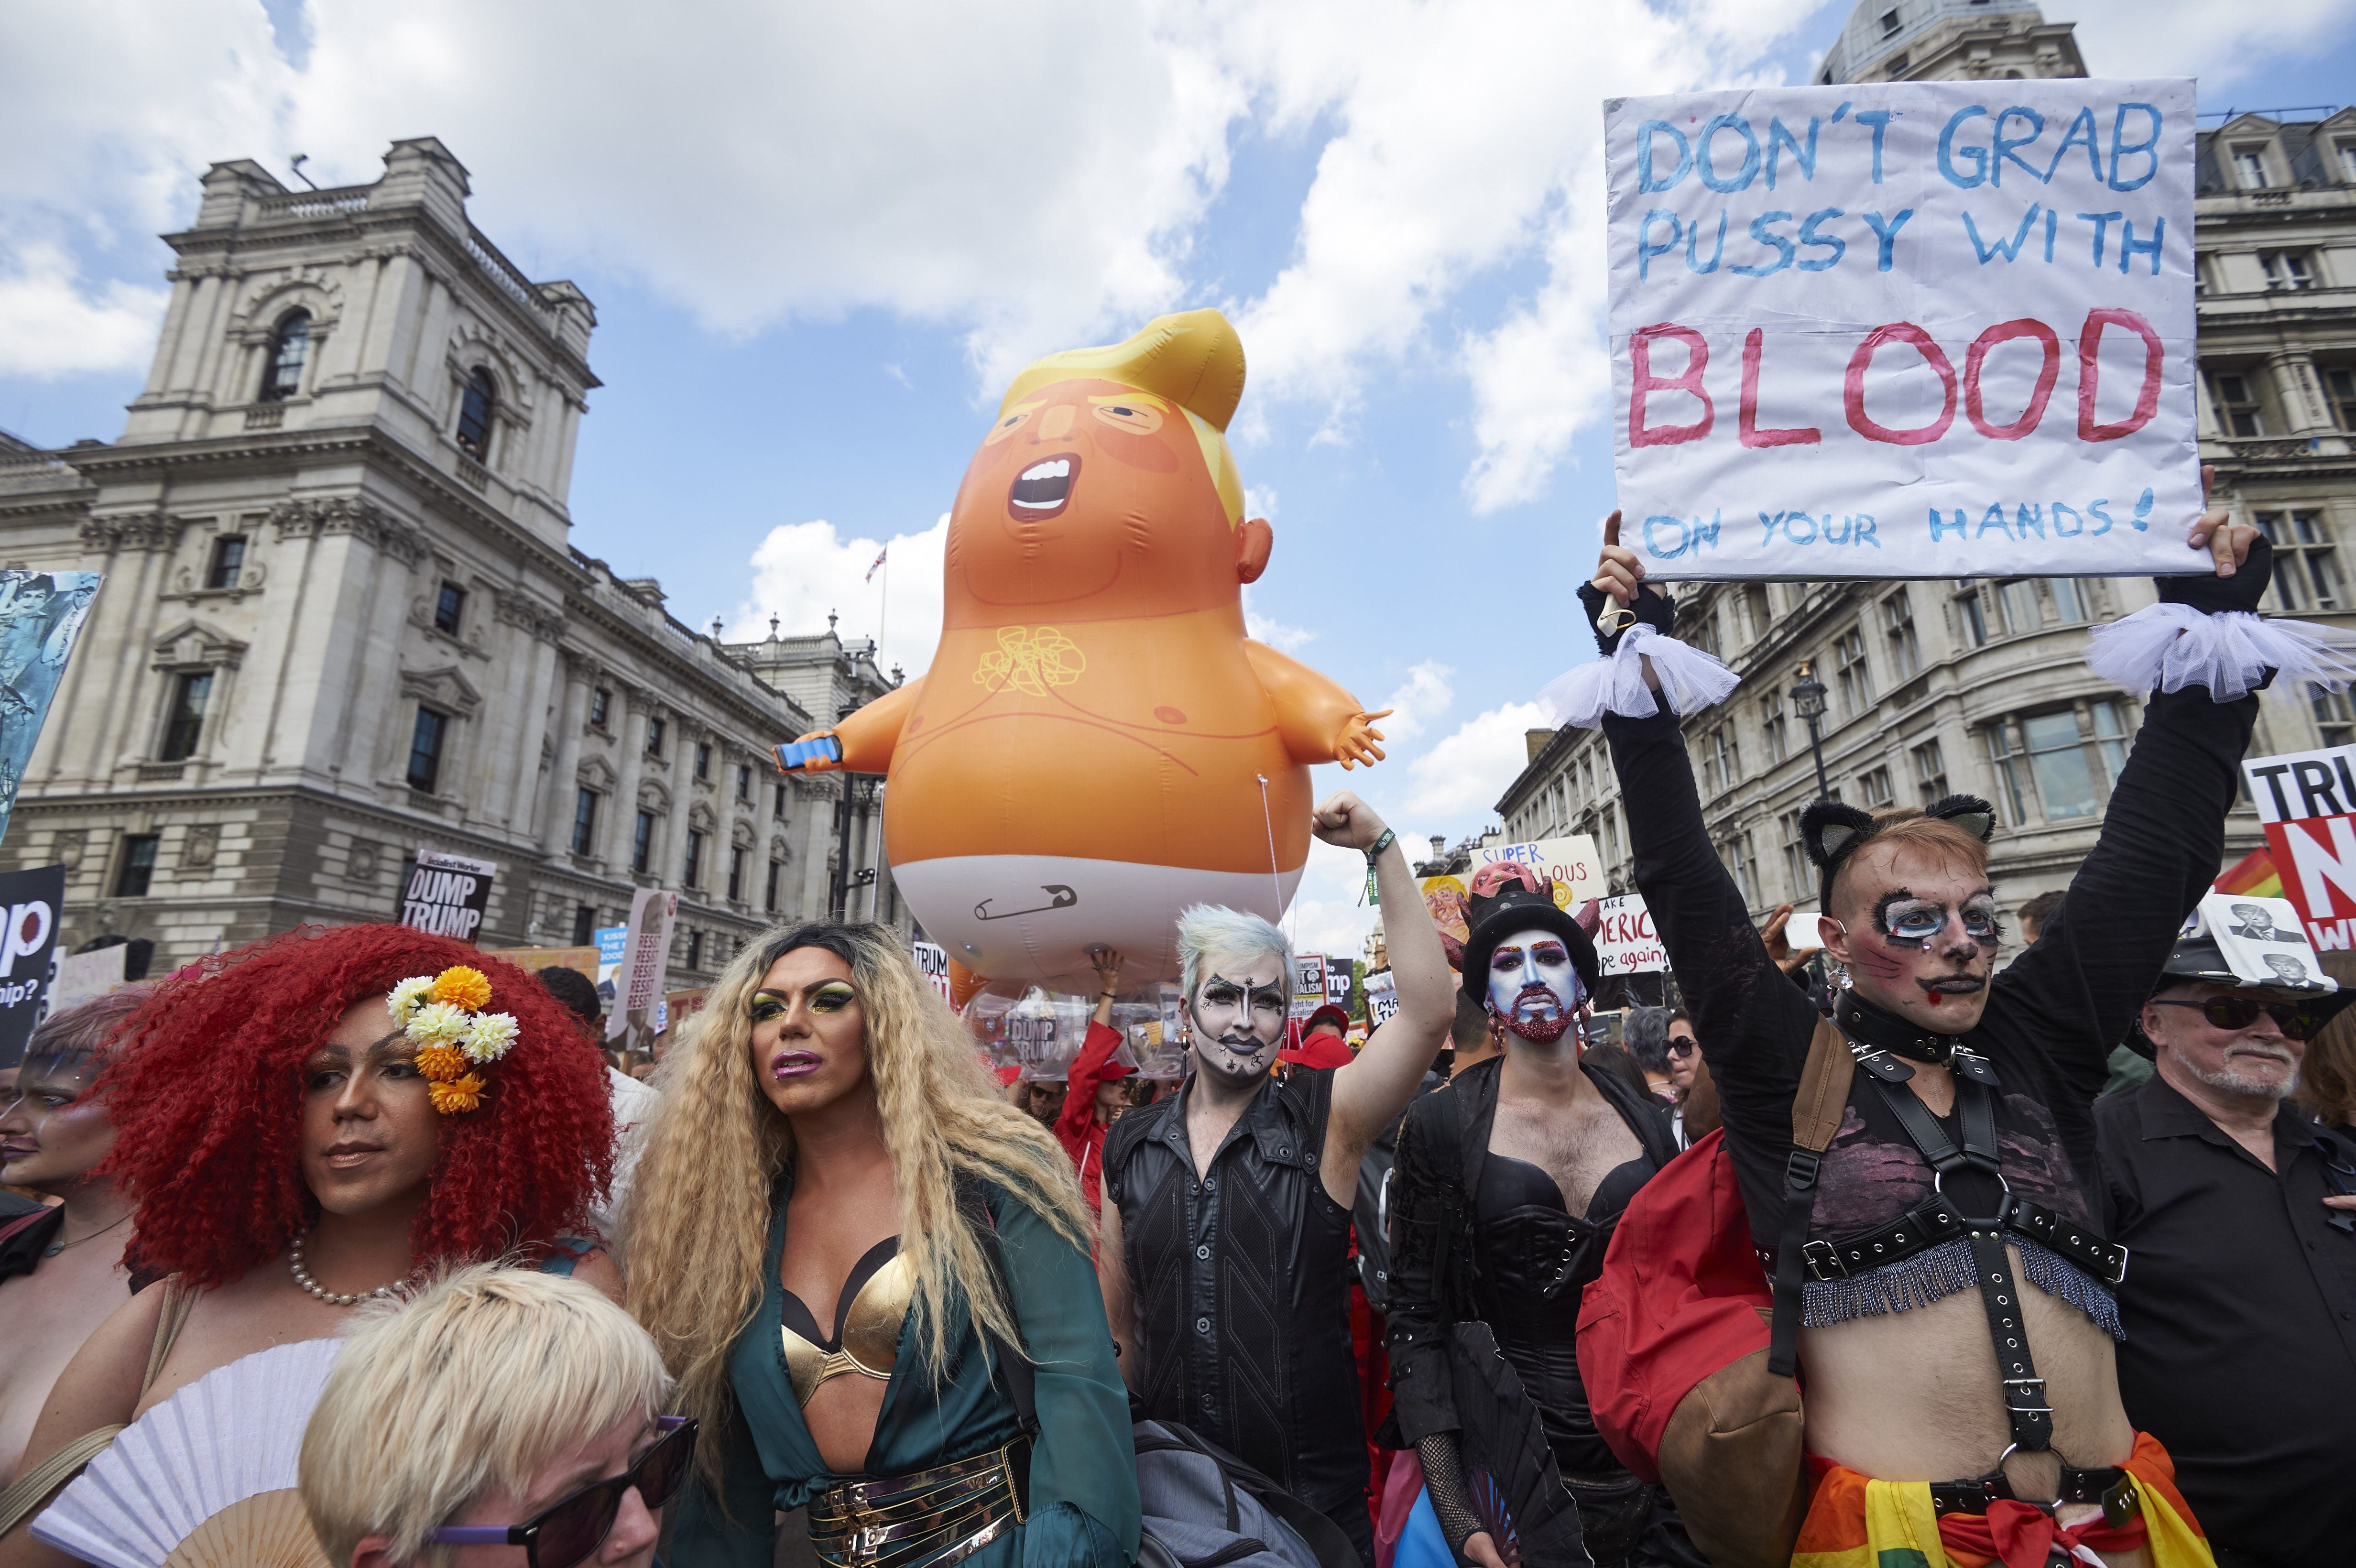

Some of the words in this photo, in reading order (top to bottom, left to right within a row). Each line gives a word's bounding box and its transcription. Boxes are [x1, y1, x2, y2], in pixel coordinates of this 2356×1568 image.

[1636, 101, 1893, 195] DON'T
[1936, 102, 2163, 192] GRAB
[1638, 207, 1914, 283] PUSSY
[1961, 202, 2165, 275] WITH
[1628, 307, 2164, 448] BLOOD
[1643, 508, 1721, 559] ON
[1758, 510, 1880, 549] YOUR
[1929, 487, 2154, 543] HANDS!
[457, 860, 481, 872] Worker
[1483, 844, 1544, 865] SUPER
[407, 868, 477, 907] DUMP
[1599, 897, 1625, 913] AKE
[402, 900, 480, 939] TRUMP
[601, 942, 620, 951] THE
[1012, 1021, 1053, 1040] DUMP
